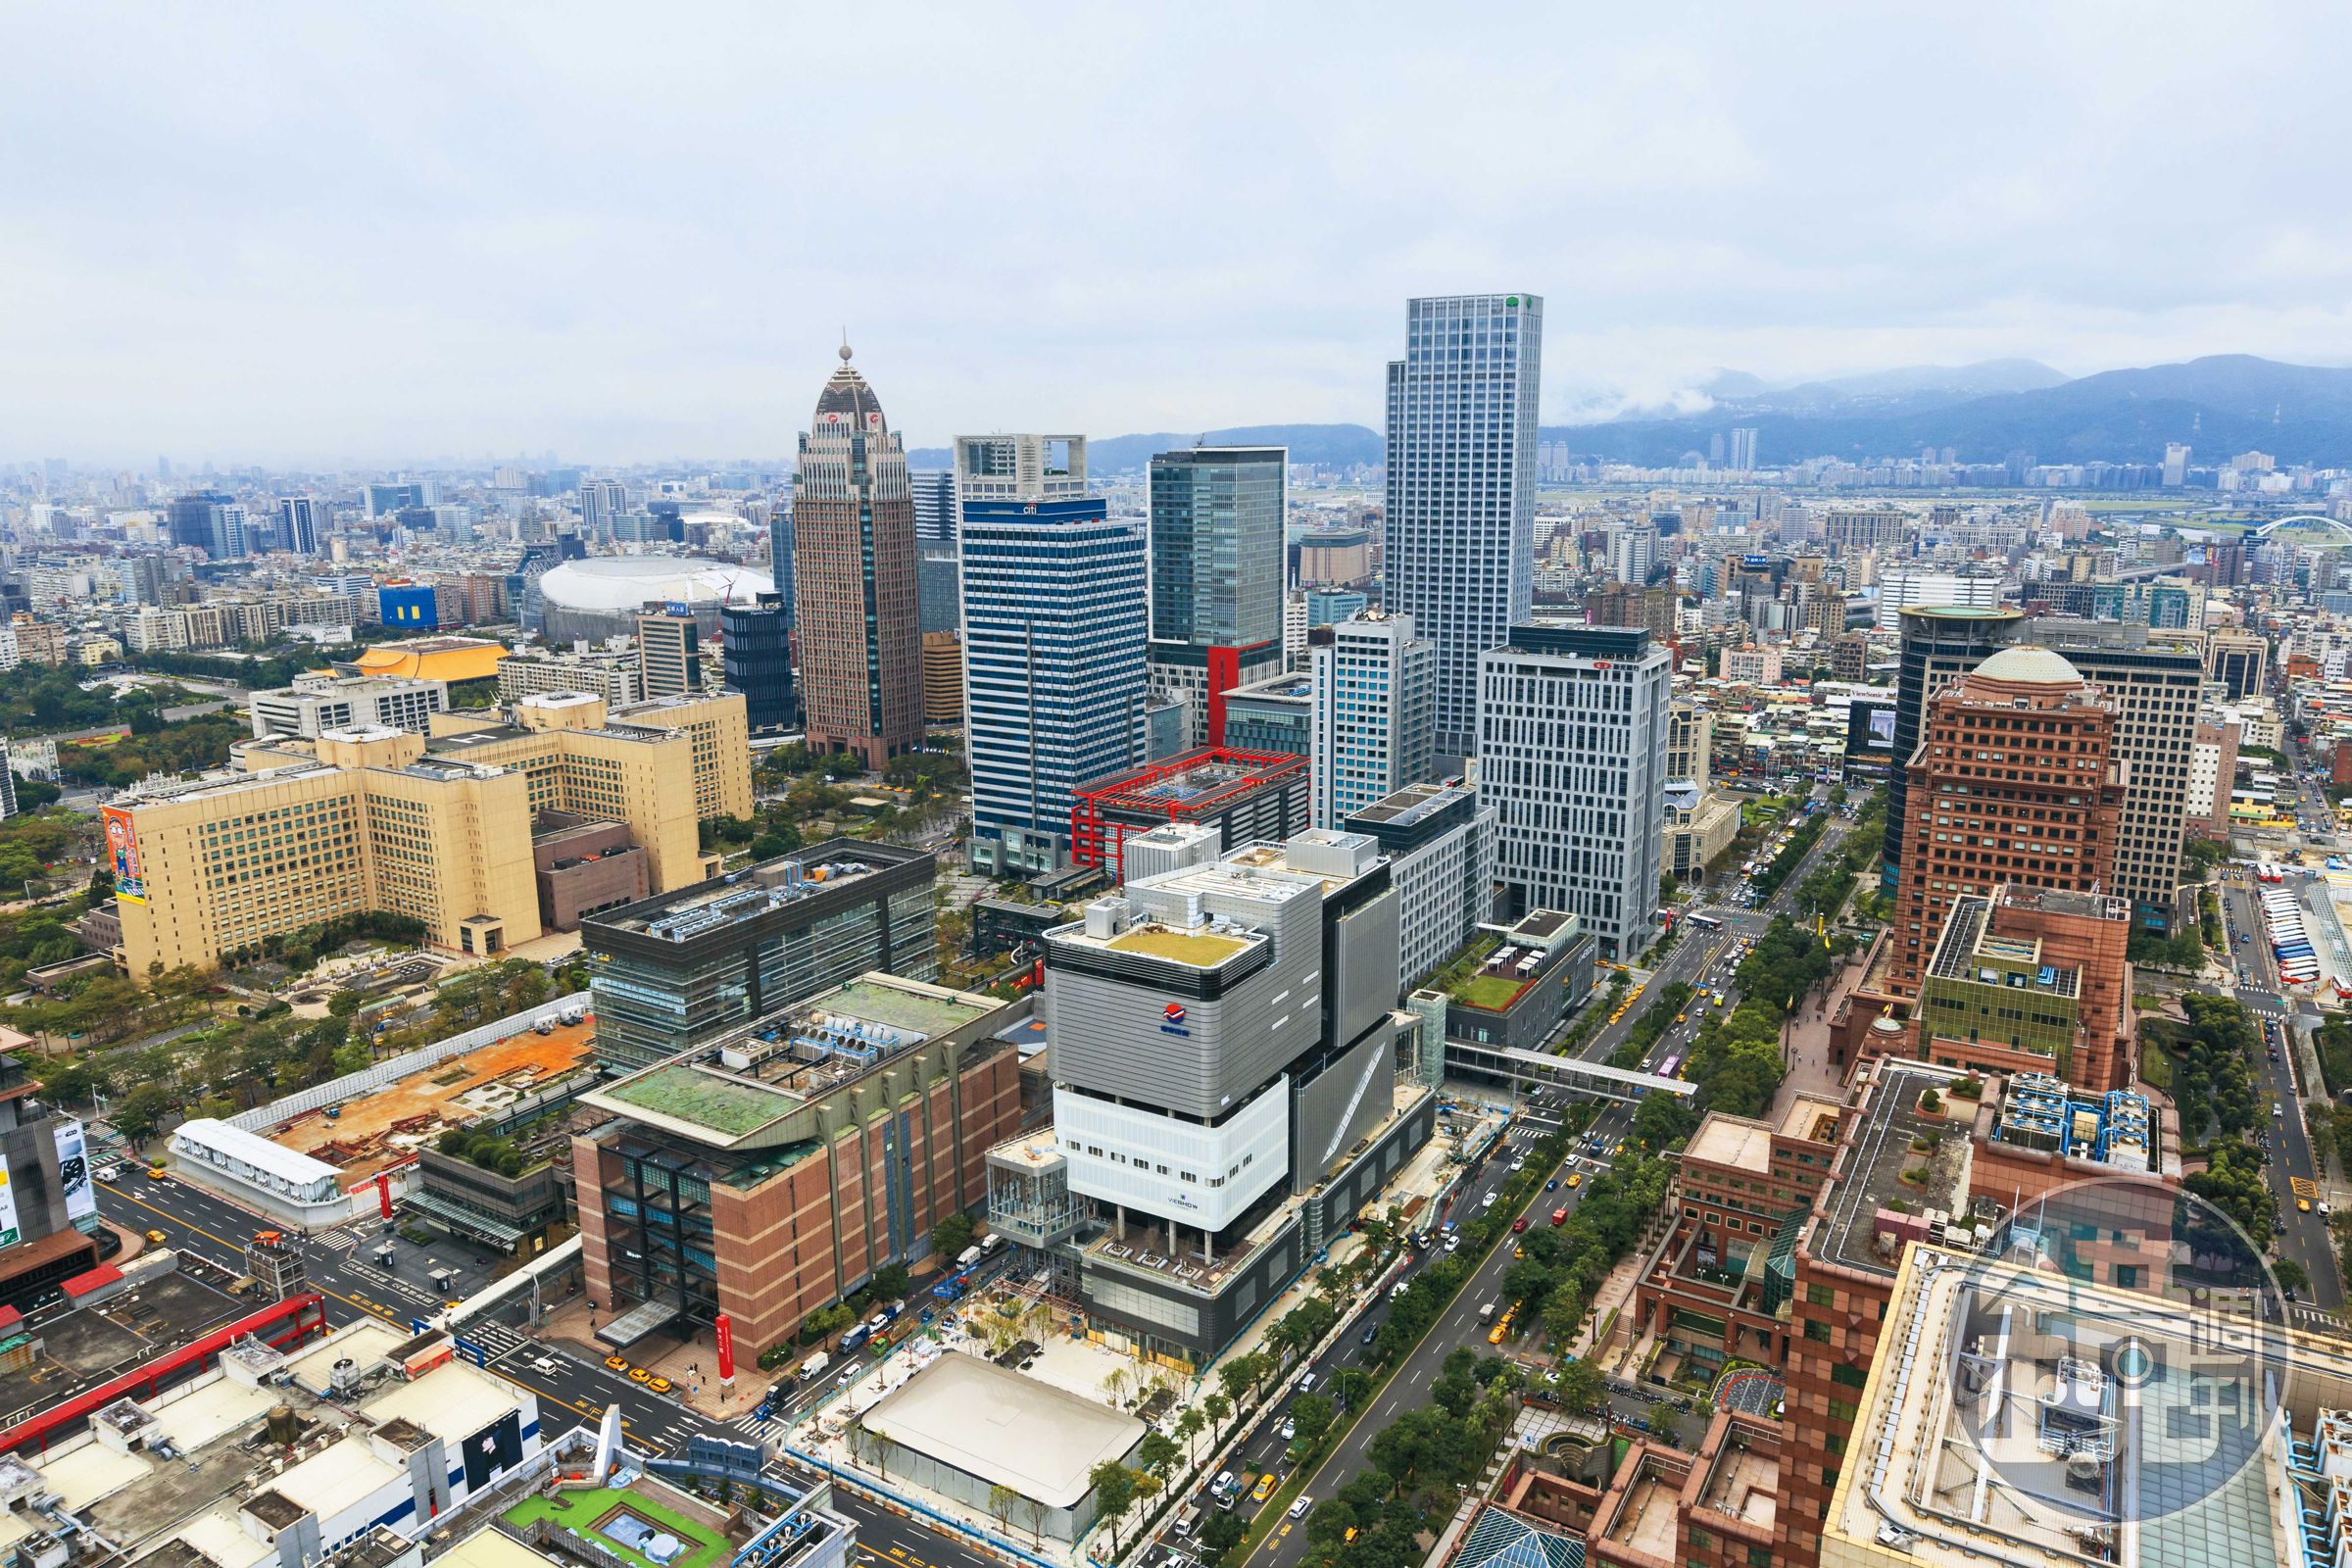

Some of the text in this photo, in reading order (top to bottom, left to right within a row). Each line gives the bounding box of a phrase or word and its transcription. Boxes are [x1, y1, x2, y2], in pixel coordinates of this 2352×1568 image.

[1023, 504, 1037, 514] citi
[1851, 689, 1884, 698] ViewSonic
[1168, 1196, 1199, 1209] VIESHOW
